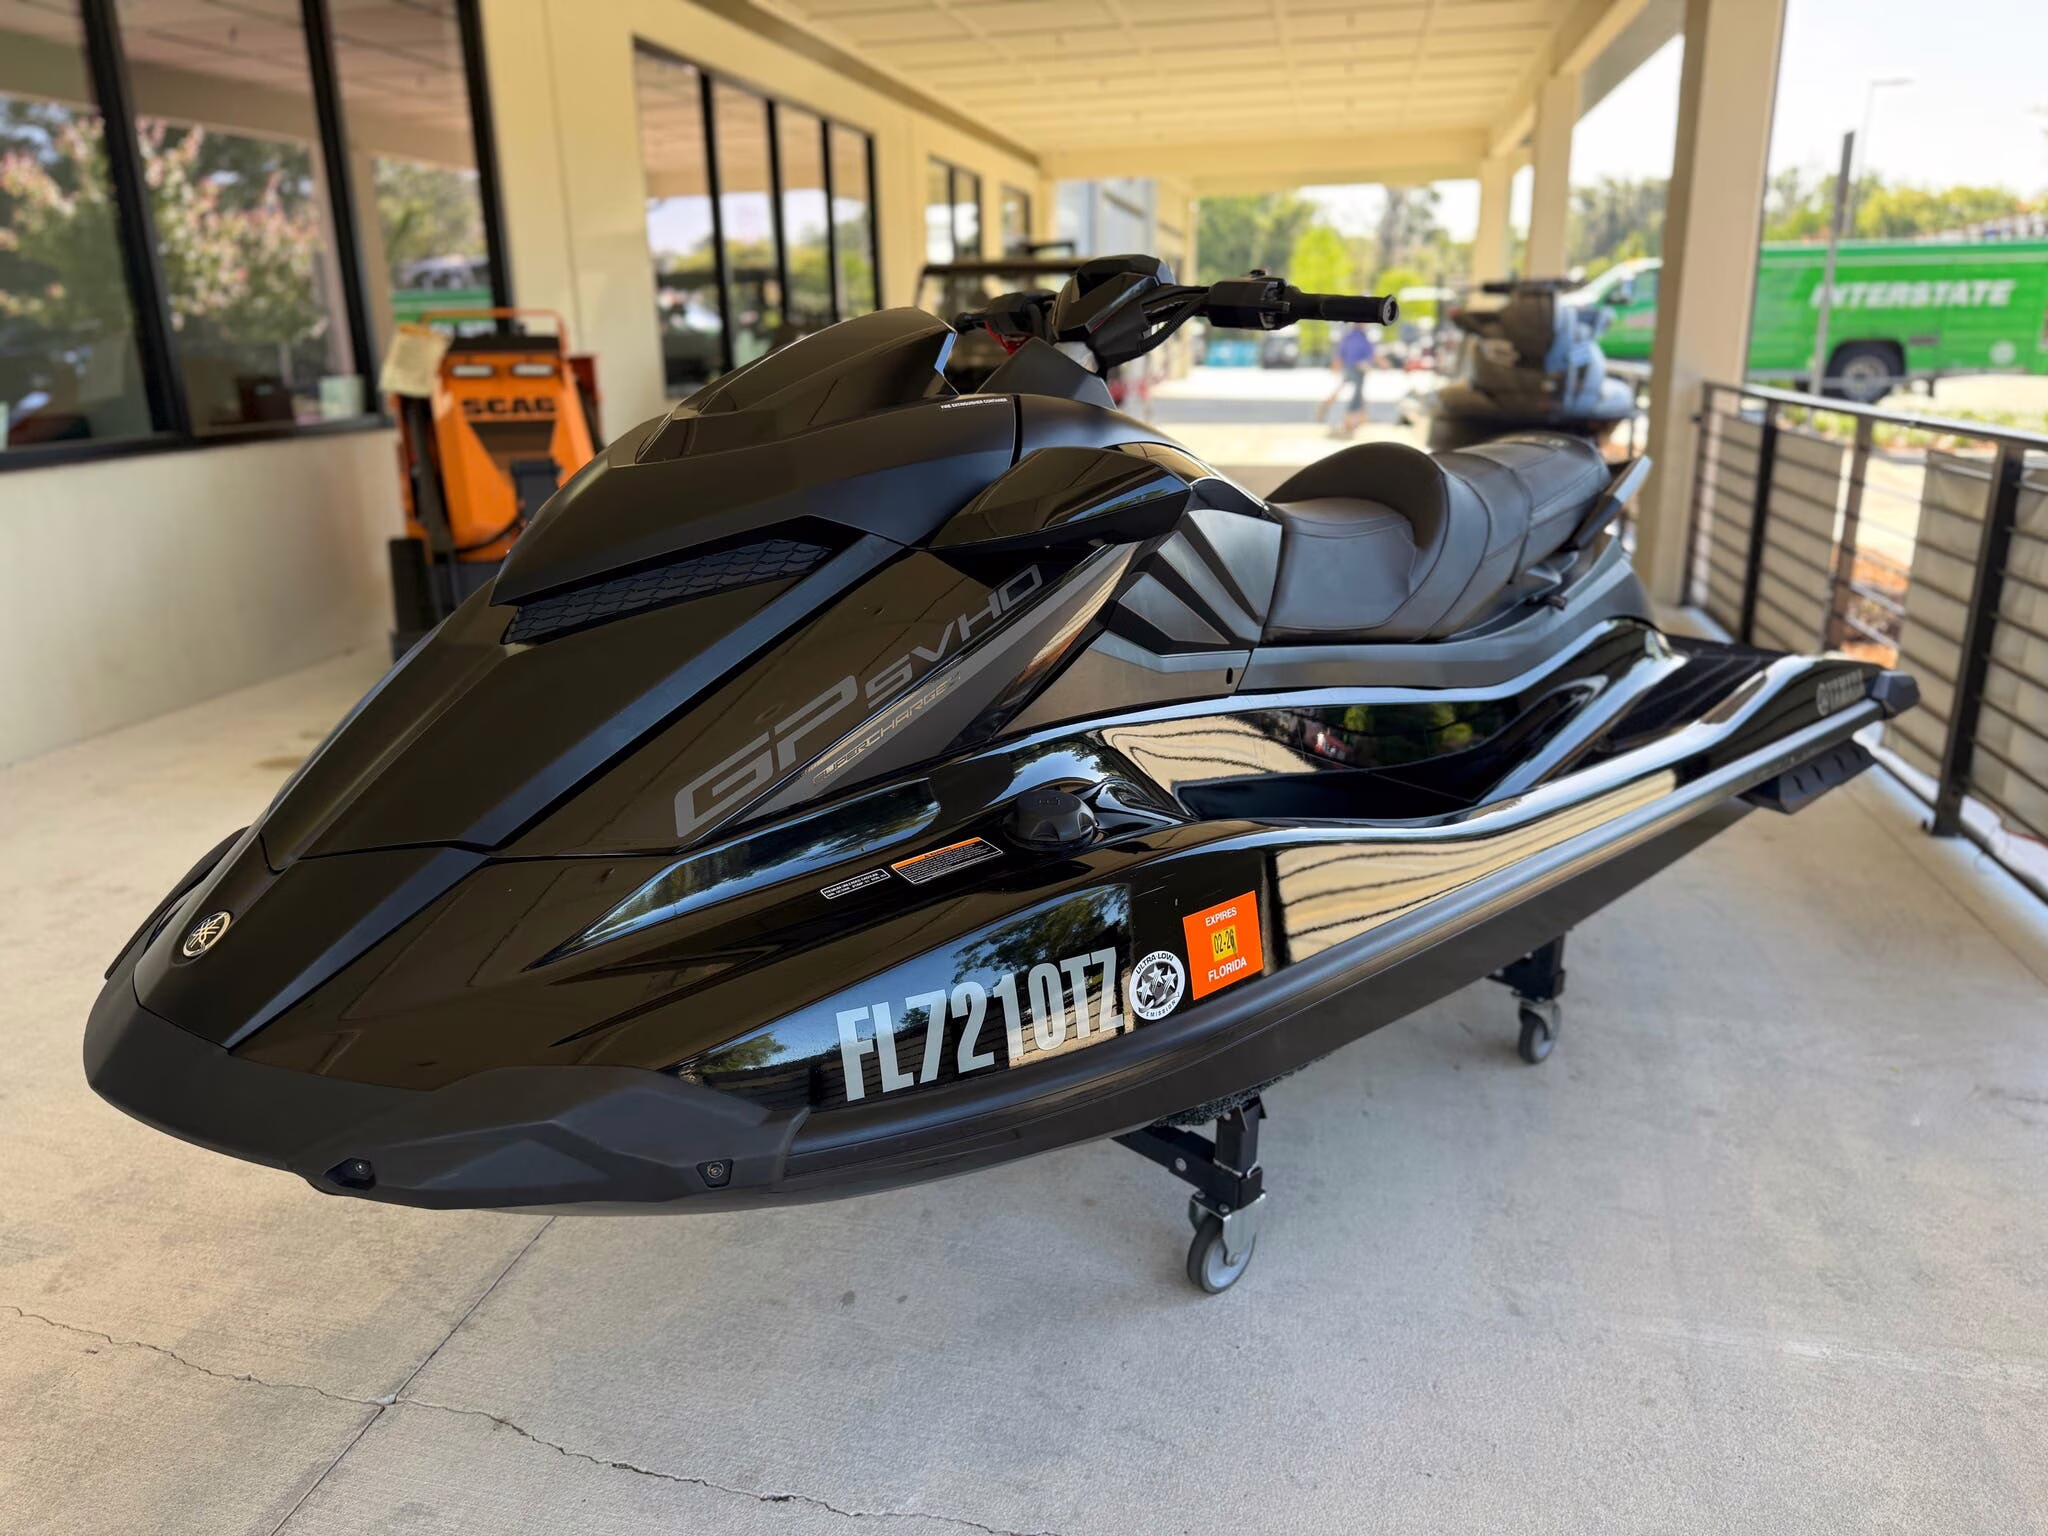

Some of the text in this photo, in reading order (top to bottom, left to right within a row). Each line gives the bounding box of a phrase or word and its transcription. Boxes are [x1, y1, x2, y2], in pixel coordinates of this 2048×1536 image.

[1810, 279, 2016, 308] INTERSTATE
[462, 398, 556, 415] SCAG
[673, 563, 1043, 838] GP SVHO
[812, 674, 961, 785] SUPERCHARGE
[1205, 906, 1238, 927] EXPIRES
[1214, 928, 1235, 954] 02-26
[1136, 952, 1174, 974] ULTRA LOW
[1208, 956, 1248, 982] FLORIDA
[1146, 1000, 1176, 1017] EMISSION
